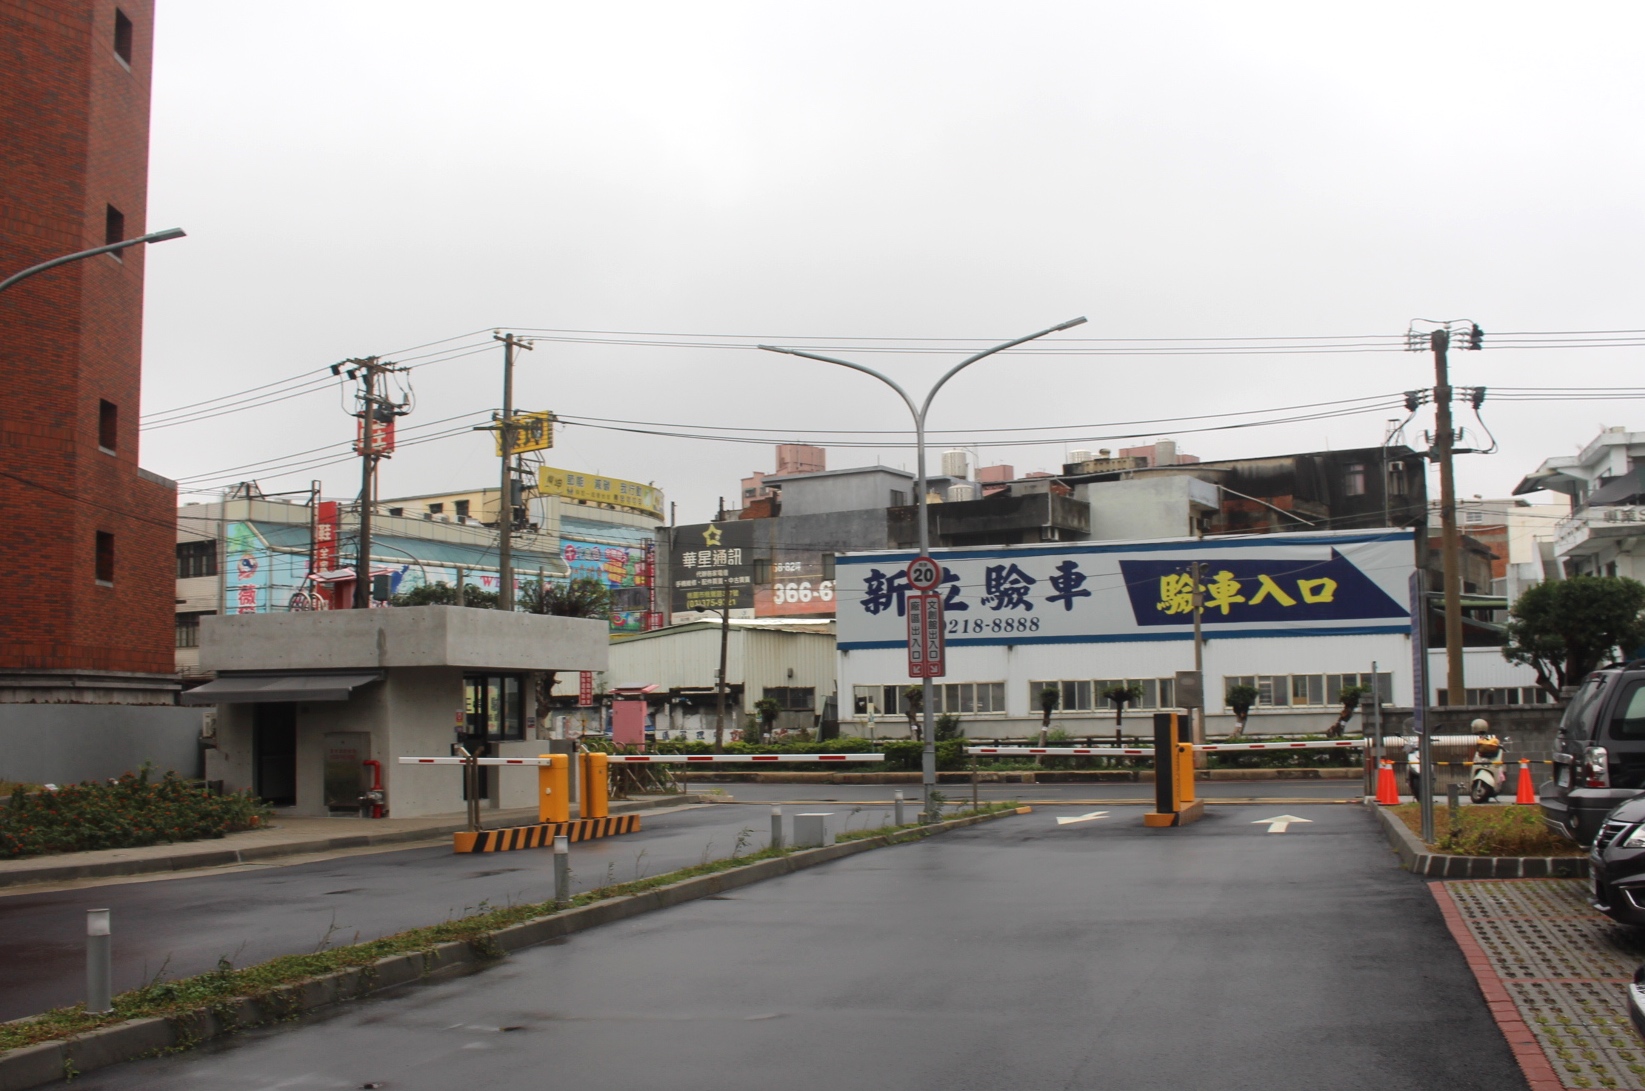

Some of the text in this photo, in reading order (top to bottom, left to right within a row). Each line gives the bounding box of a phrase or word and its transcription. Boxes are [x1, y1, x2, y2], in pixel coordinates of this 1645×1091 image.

[682, 548, 743, 568] 華星通訊
[913, 568, 934, 583] 20
[773, 580, 836, 605] 366-6
[1156, 570, 1338, 615] 驗車入口
[910, 601, 921, 660] 廠區出入口
[927, 601, 939, 659] 文創館出入口
[942, 616, 1040, 635] 218-8888
